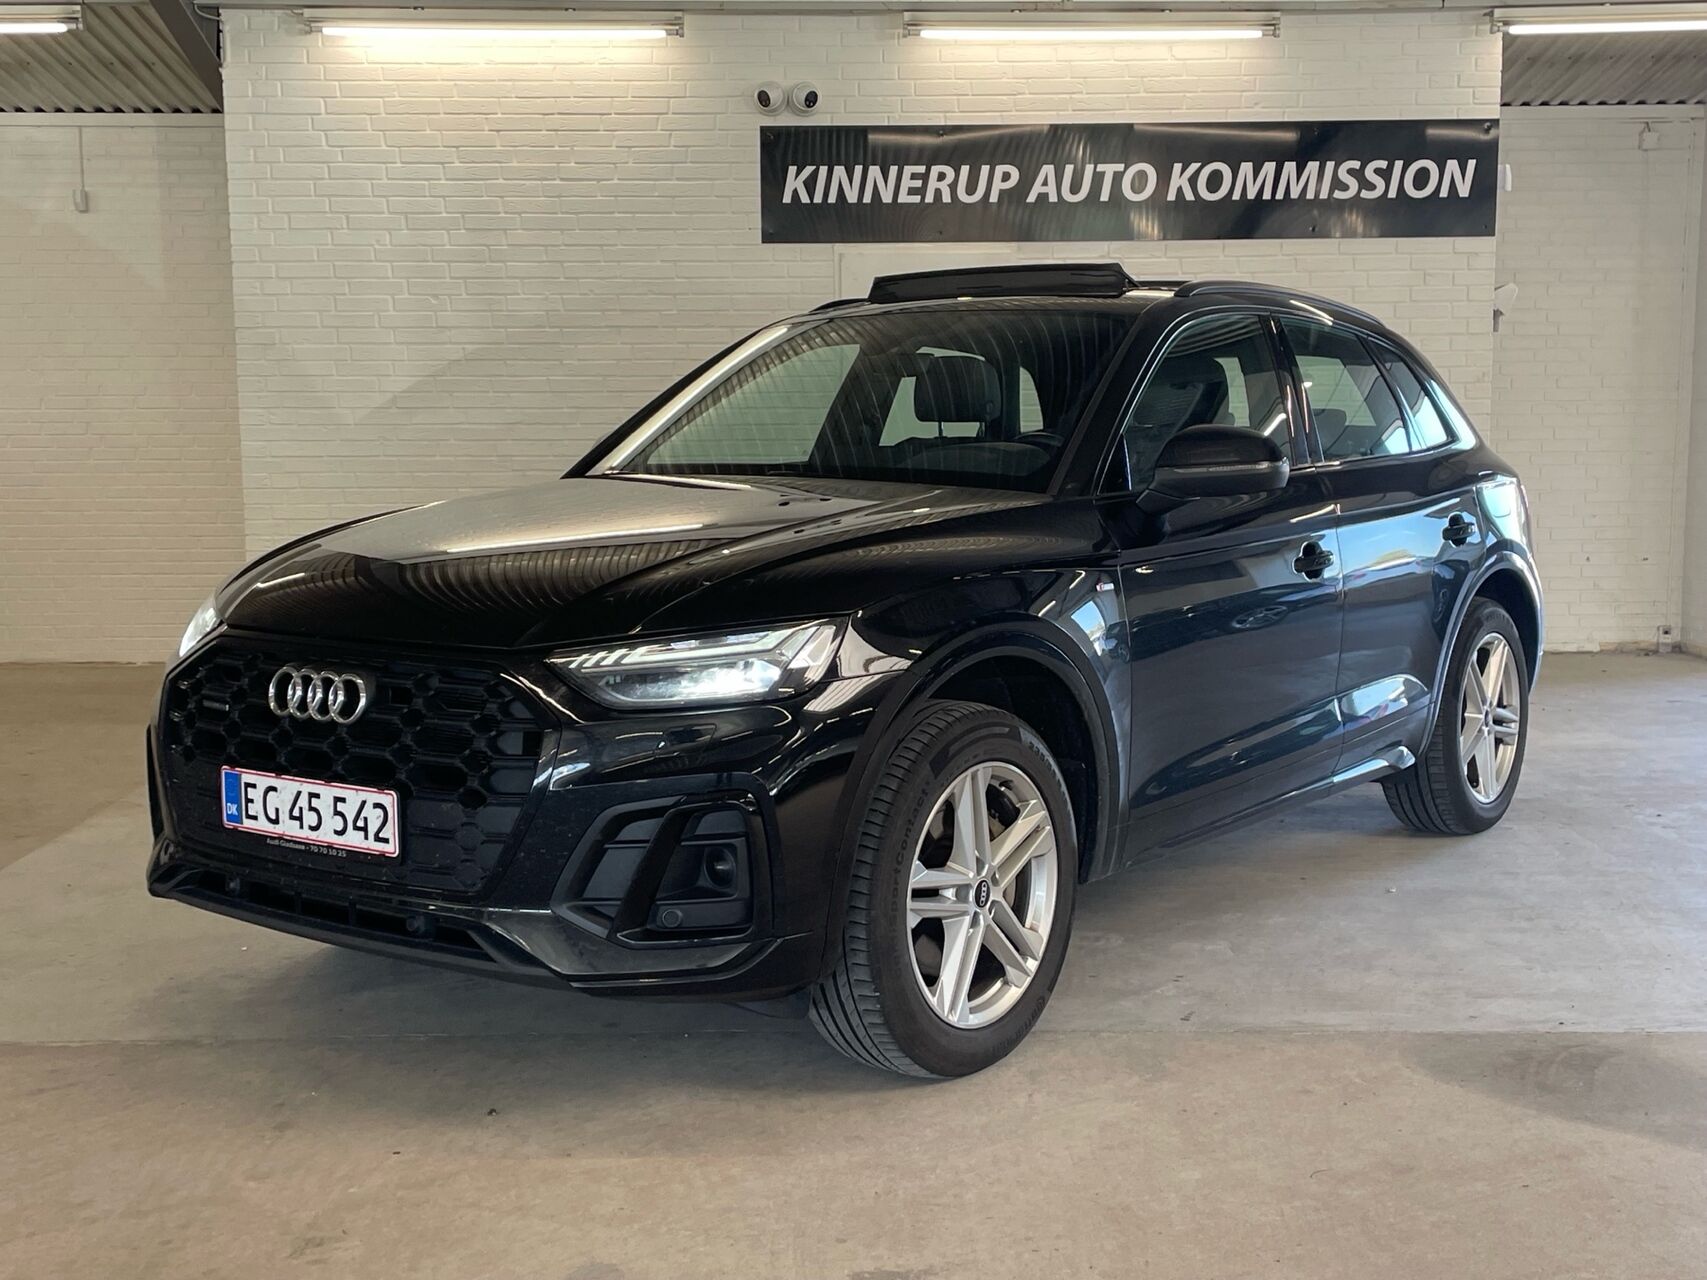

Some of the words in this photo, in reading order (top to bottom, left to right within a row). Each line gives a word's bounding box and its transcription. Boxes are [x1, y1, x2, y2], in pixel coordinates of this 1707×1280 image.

[782, 164, 1021, 204] KINNERUP
[1026, 162, 1158, 203] AUTO
[1165, 158, 1477, 202] KOMMISSION
[227, 803, 238, 815] DK
[244, 782, 280, 825] EG
[289, 790, 323, 831] 45
[333, 796, 390, 844] 542
[310, 845, 318, 853] 70
[319, 846, 327, 854] 70
